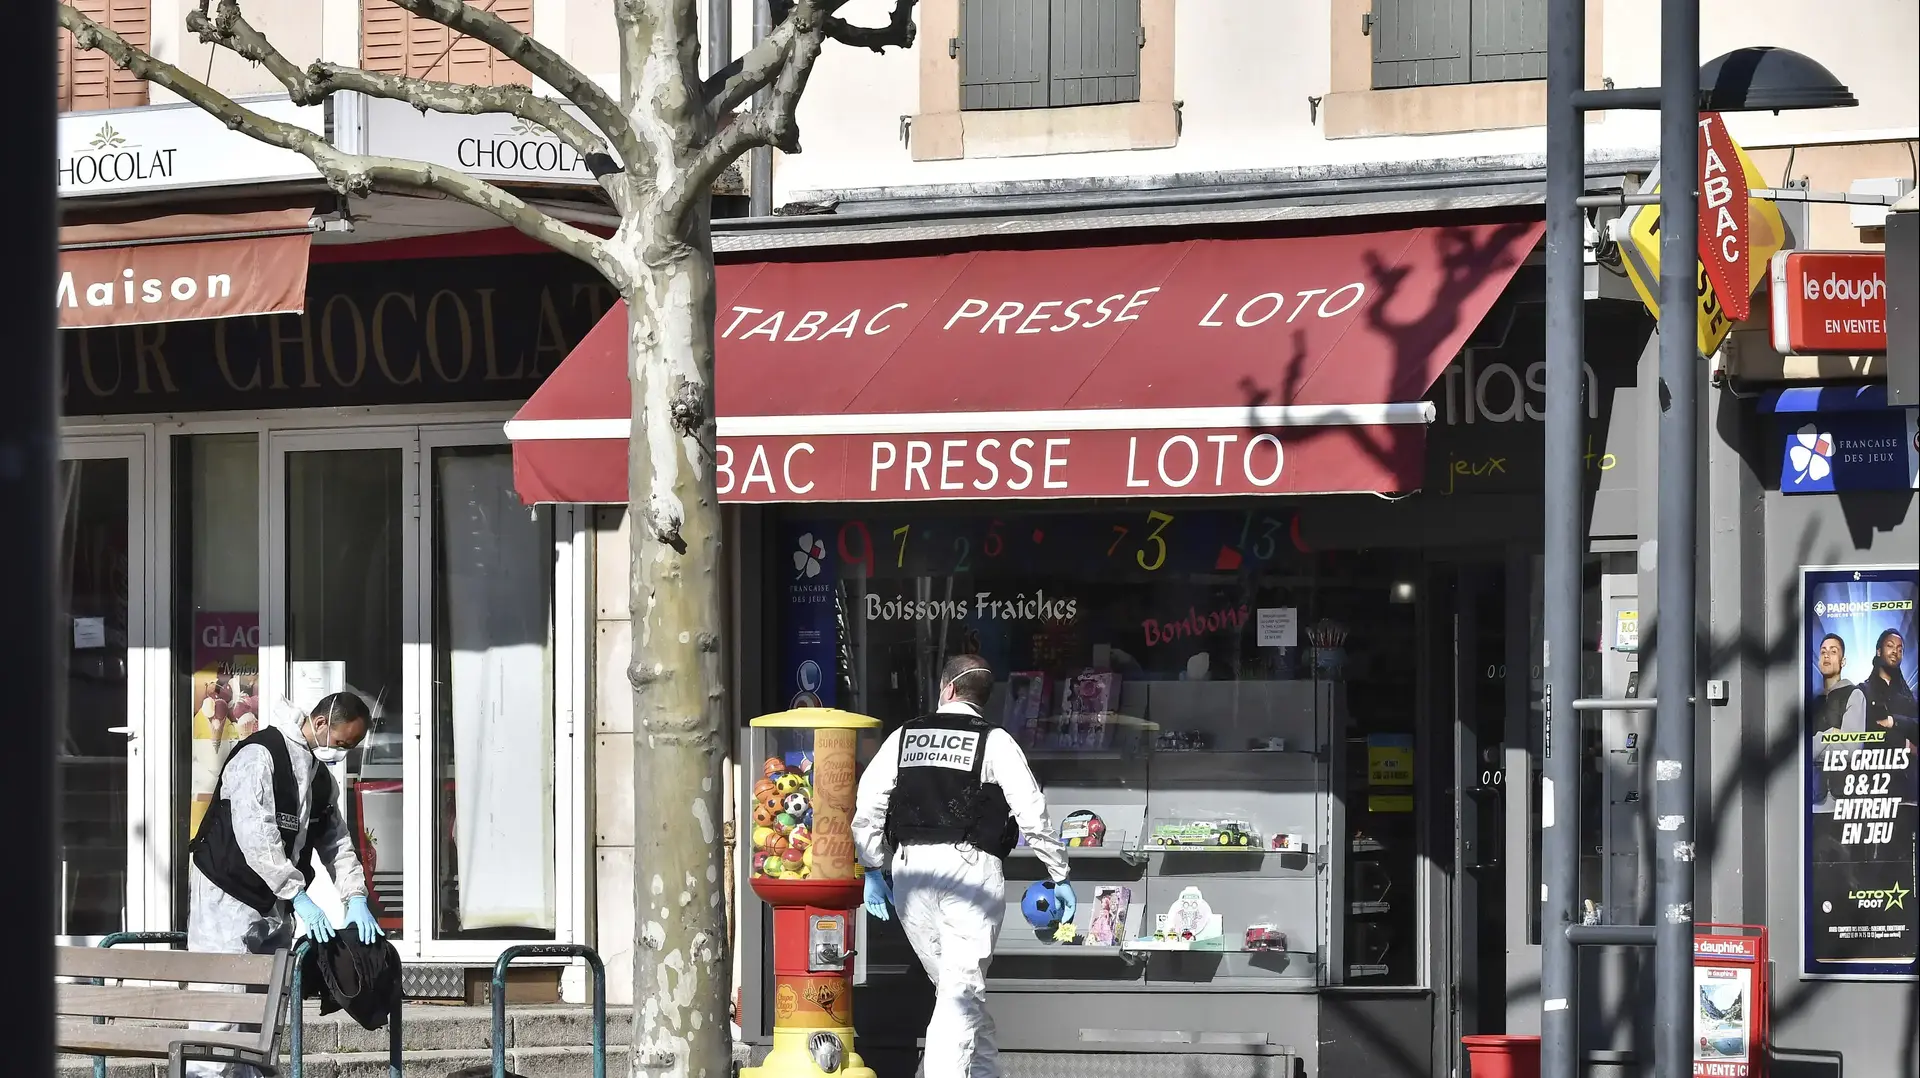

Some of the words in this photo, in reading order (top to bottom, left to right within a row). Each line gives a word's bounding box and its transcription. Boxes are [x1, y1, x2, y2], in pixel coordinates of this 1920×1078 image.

[1698, 116, 1740, 264] TABAC
[1803, 271, 1820, 300] le
[1822, 271, 1886, 306] dauph
[722, 302, 909, 343] TABAC
[943, 286, 1161, 335] PRESSE
[1198, 282, 1366, 328] LOTO
[1825, 319, 1841, 334] EN
[1842, 319, 1881, 334] VENTE
[870, 437, 1071, 492] PRESSE
[1126, 433, 1285, 489] LOTO
[1844, 453, 1864, 463] DES
[1867, 453, 1894, 464] JEUX
[1440, 453, 1507, 496] jeux
[1137, 510, 1174, 571] 3
[864, 592, 968, 621] Boissons
[975, 588, 1077, 621] Fraîches
[1827, 602, 1870, 612] PARIONS
[1871, 601, 1912, 610] SPORT
[1142, 604, 1248, 647] Bonbons
[1621, 621, 1638, 633] RO
[904, 733, 975, 752] POLICE
[1821, 733, 1886, 743] NOUVEAU
[903, 751, 971, 766] JUDICIAIRE
[1822, 749, 1849, 772] LES
[1850, 748, 1911, 771] GRILLES
[1843, 774, 1856, 796] 8
[1870, 773, 1891, 795] 12
[276, 812, 299, 824] POLICE
[1833, 797, 1902, 820] ENTRENT
[1841, 822, 1863, 845] EN
[1863, 822, 1894, 844] JEU
[1848, 891, 1885, 899] LOTO
[1858, 900, 1884, 909] FOOT
[1700, 940, 1744, 955] dauphiné
[1706, 1063, 1736, 1076] VENTE
